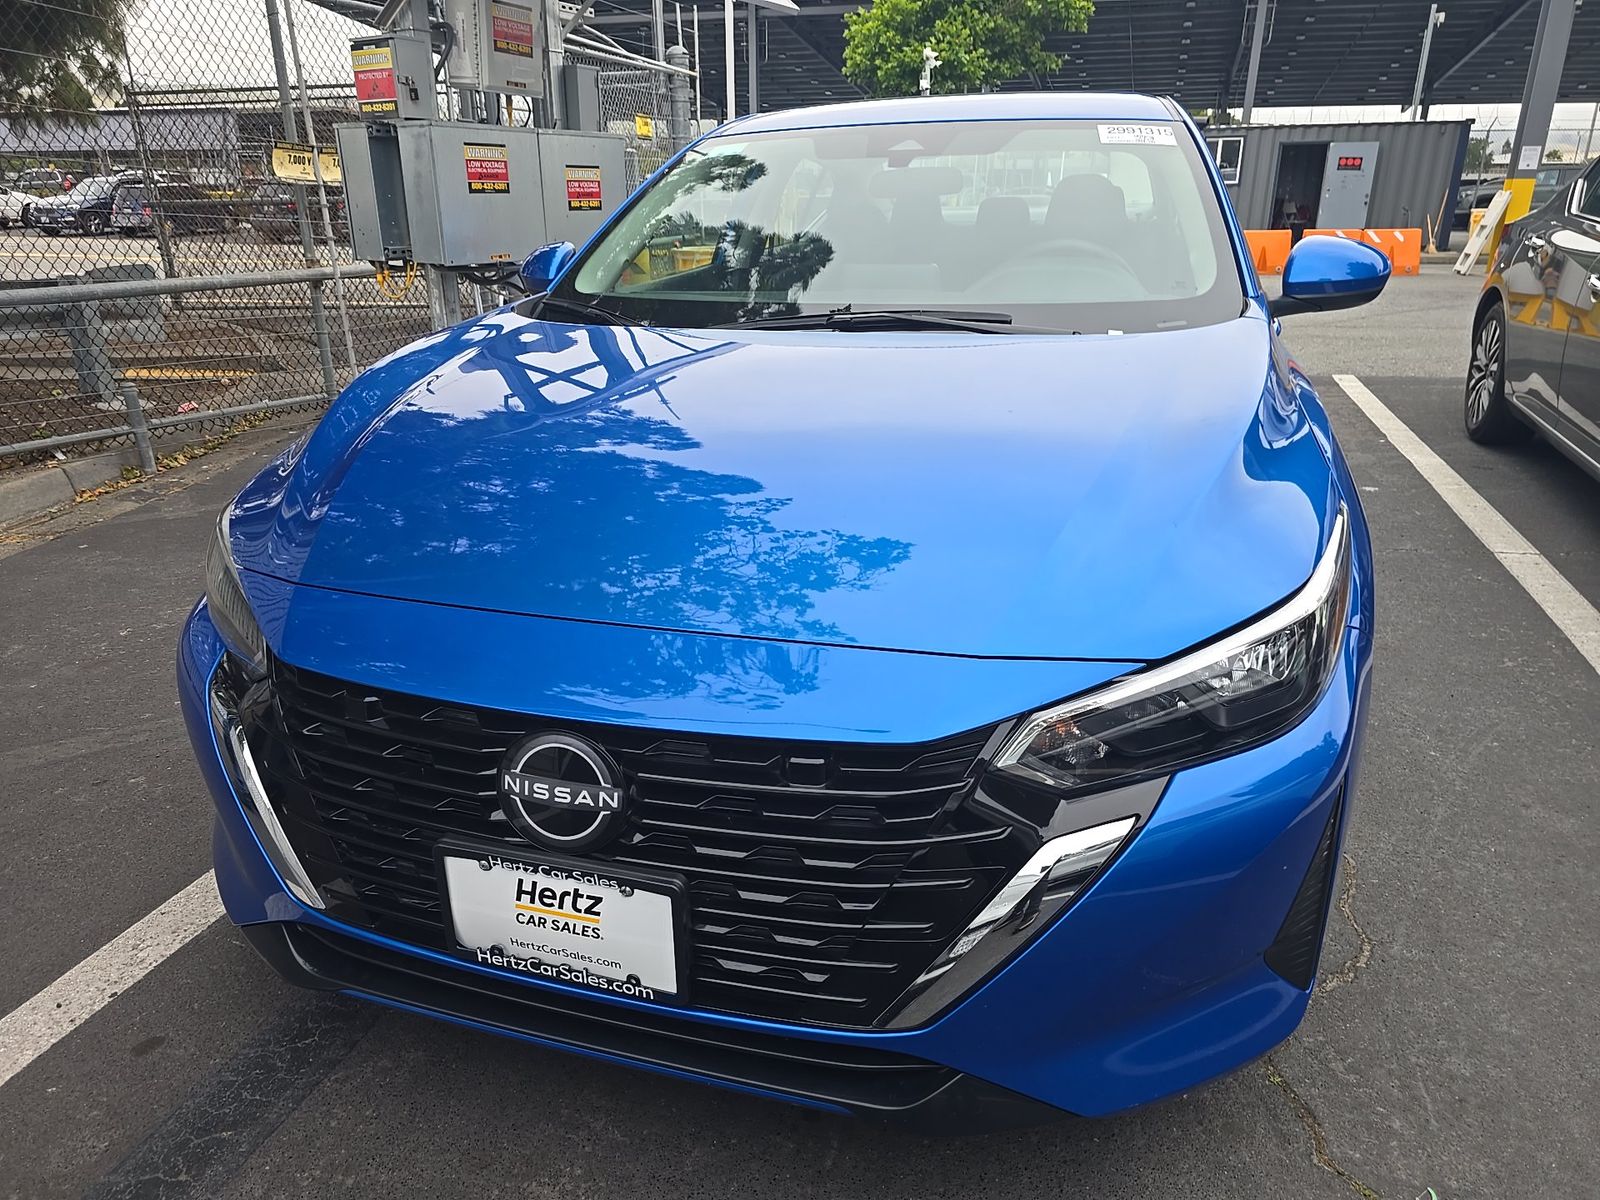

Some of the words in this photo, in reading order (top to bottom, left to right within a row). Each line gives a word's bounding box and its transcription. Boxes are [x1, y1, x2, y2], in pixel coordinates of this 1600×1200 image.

[494, 18, 507, 27] LOW
[507, 21, 530, 31] VOLTAGE
[358, 72, 382, 80] PROTECTED
[1107, 126, 1173, 137] 2991315
[287, 154, 306, 166] 7,000
[467, 160, 481, 168] LOW
[481, 161, 505, 169] VOLTAGE
[471, 182, 508, 190] 800-432-6391
[504, 773, 620, 810] NISSAN
[488, 855, 537, 876] Hertz
[538, 864, 568, 881] Car
[573, 871, 619, 890] Sales
[515, 878, 604, 917] Hertz
[515, 912, 547, 930] CAR
[509, 936, 622, 970] HertzCarSales.com
[476, 947, 655, 1001] HertzCarSales.com
